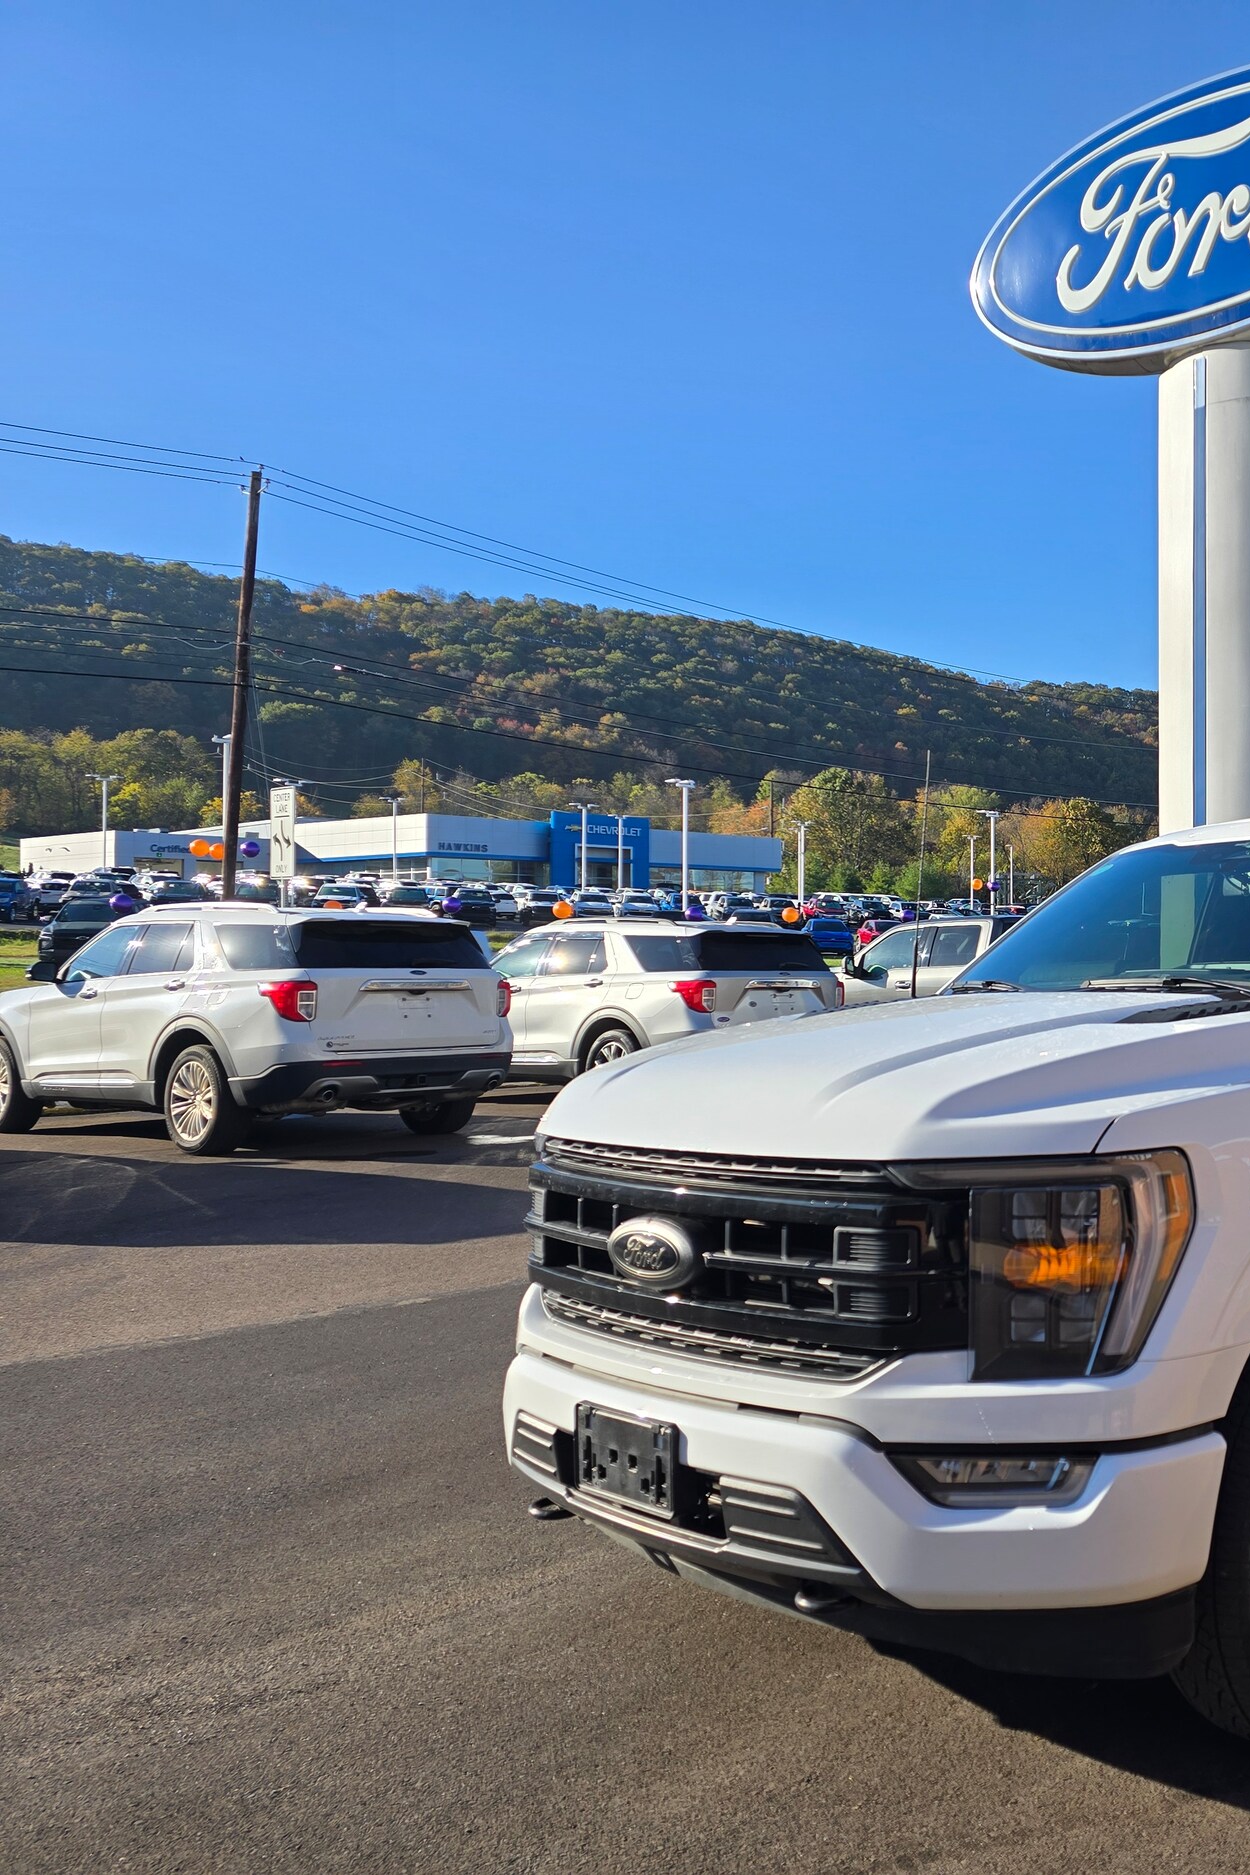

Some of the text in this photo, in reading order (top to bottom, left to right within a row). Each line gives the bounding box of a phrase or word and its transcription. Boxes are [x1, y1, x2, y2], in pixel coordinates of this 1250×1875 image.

[273, 793, 290, 802] CENTER
[275, 803, 288, 813] LANE
[438, 842, 489, 853] HAWKINS
[275, 864, 288, 873] ONLY
[623, 1235, 666, 1270] Ford
